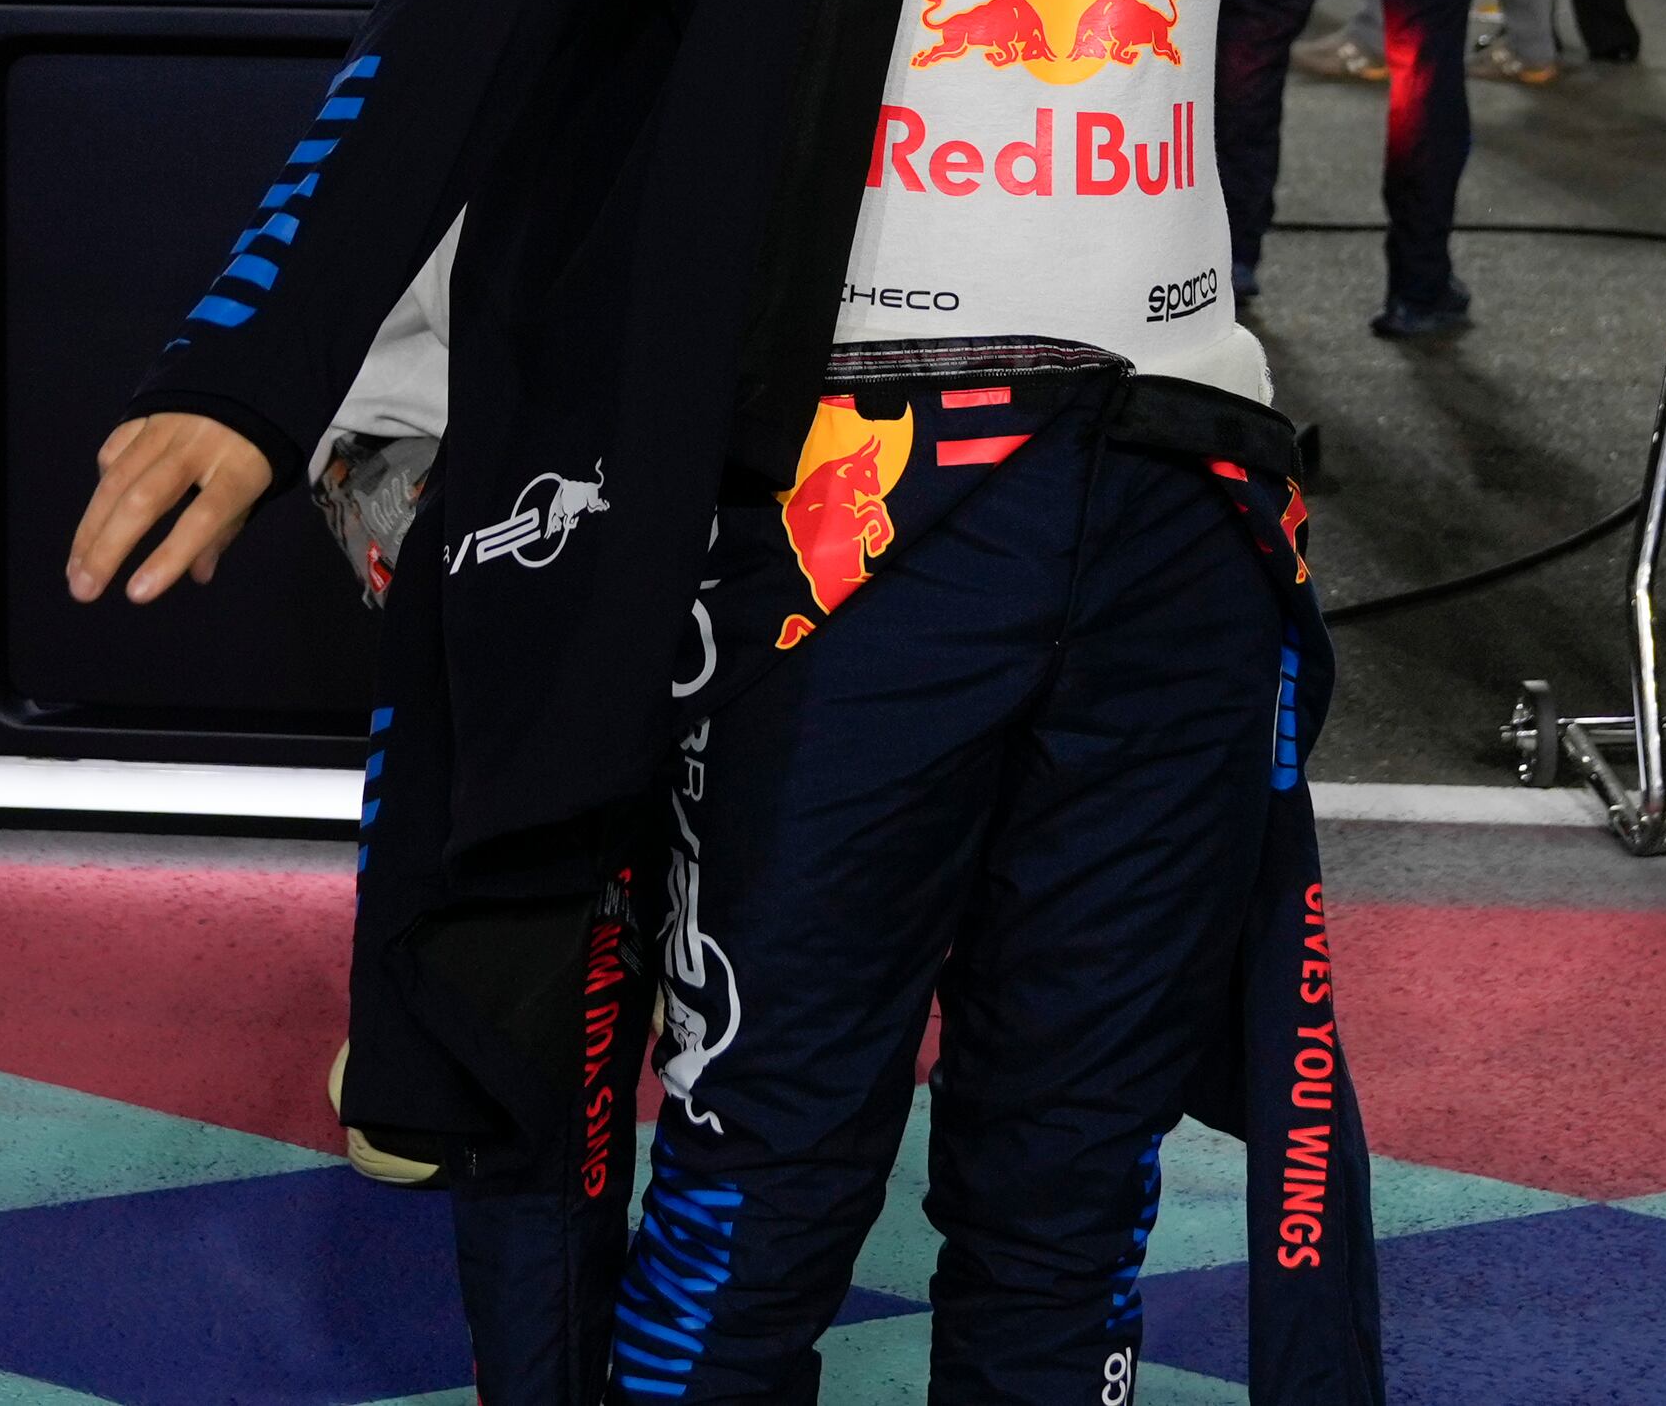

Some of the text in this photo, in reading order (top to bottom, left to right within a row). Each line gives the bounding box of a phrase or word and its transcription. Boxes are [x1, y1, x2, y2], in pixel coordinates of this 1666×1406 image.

[865, 101, 1195, 197] Red Bull
[1146, 267, 1218, 323] sparco
[584, 1000, 619, 1089] YOU
[1290, 1018, 1334, 1111] YOU
[1277, 1124, 1332, 1271] WINGS
